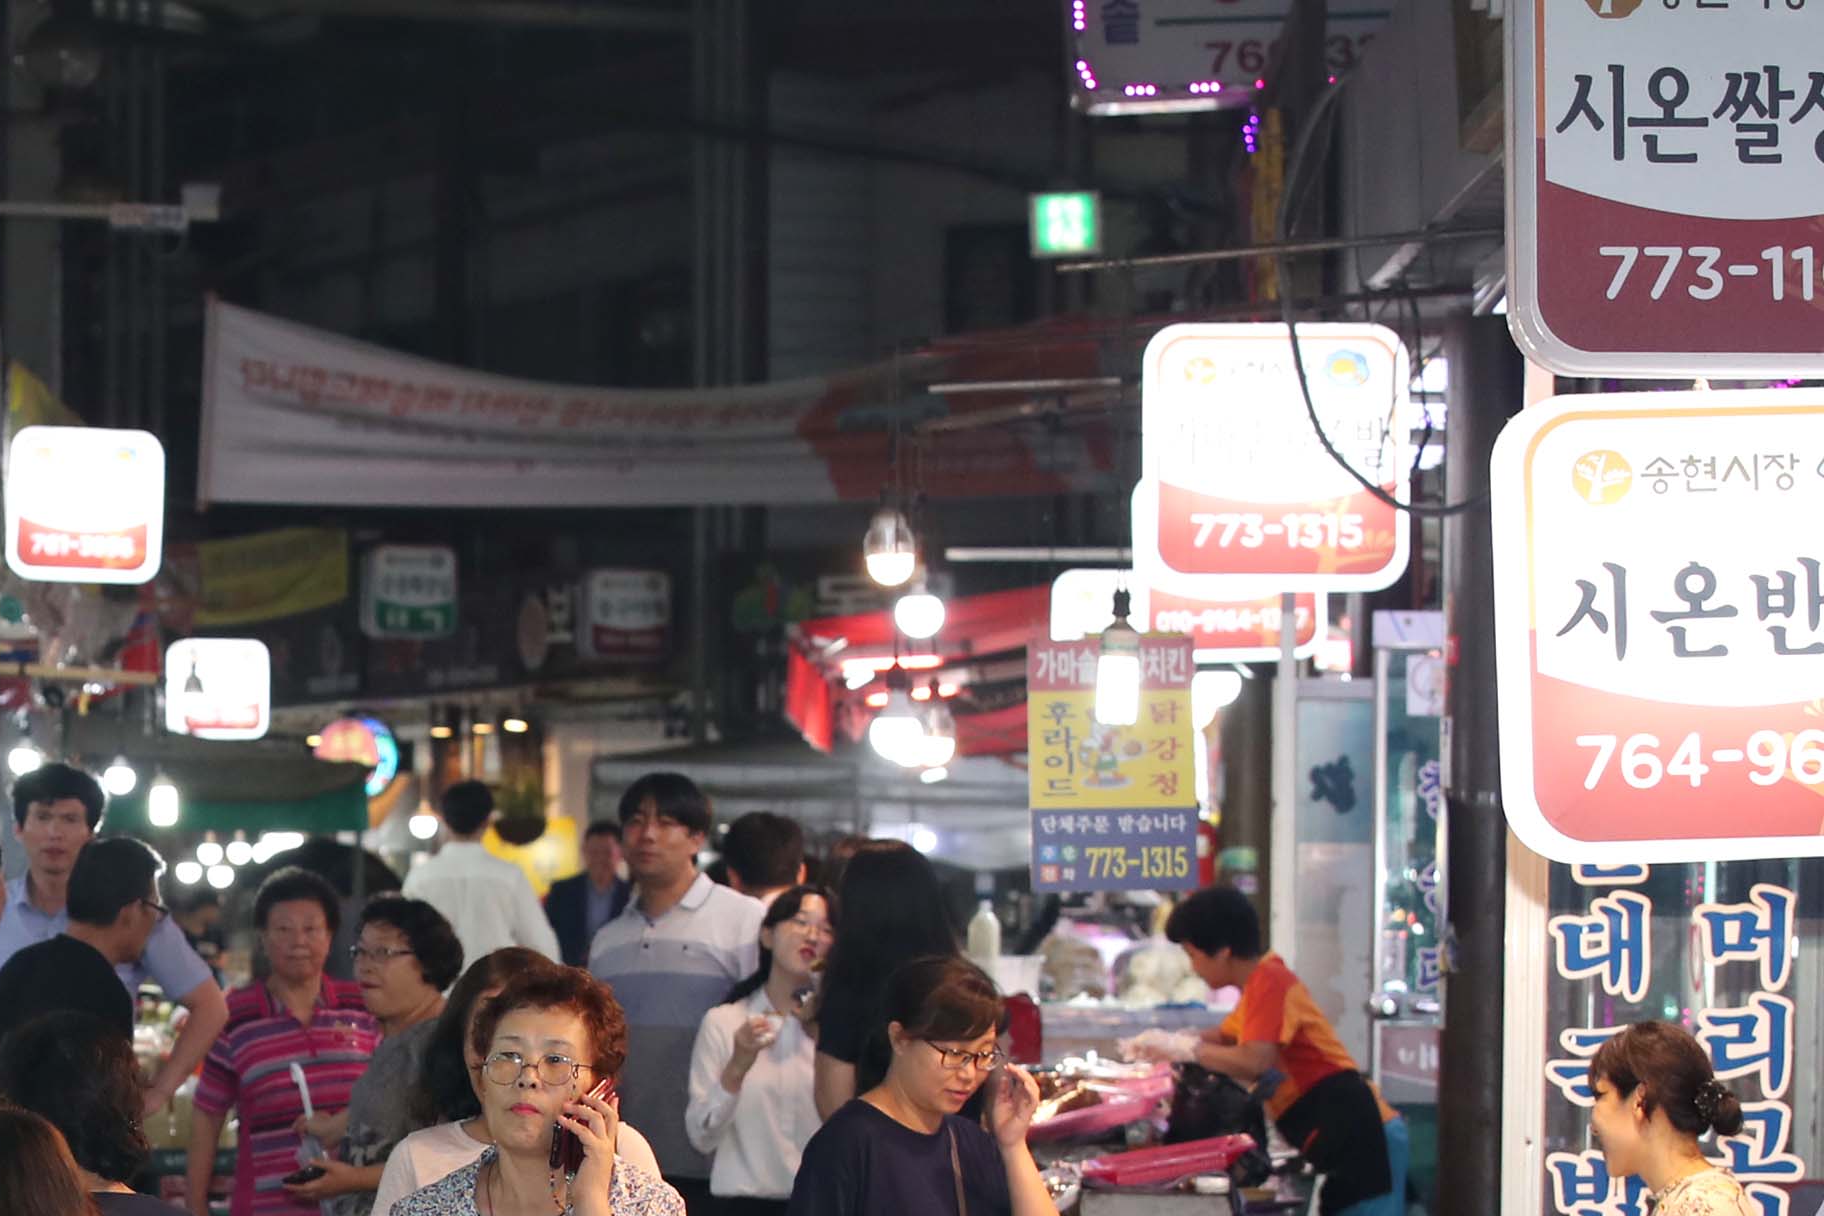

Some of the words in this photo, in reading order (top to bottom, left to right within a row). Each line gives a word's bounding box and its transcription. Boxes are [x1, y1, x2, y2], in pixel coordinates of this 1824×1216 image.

[1600, 246, 1824, 300] 773-11
[1640, 453, 1800, 494] 송현시장
[1190, 512, 1364, 548] 773-1315
[1042, 700, 1077, 797] 후라이드
[1148, 700, 1184, 797] 닭강정
[1084, 846, 1189, 878] 773-1315
